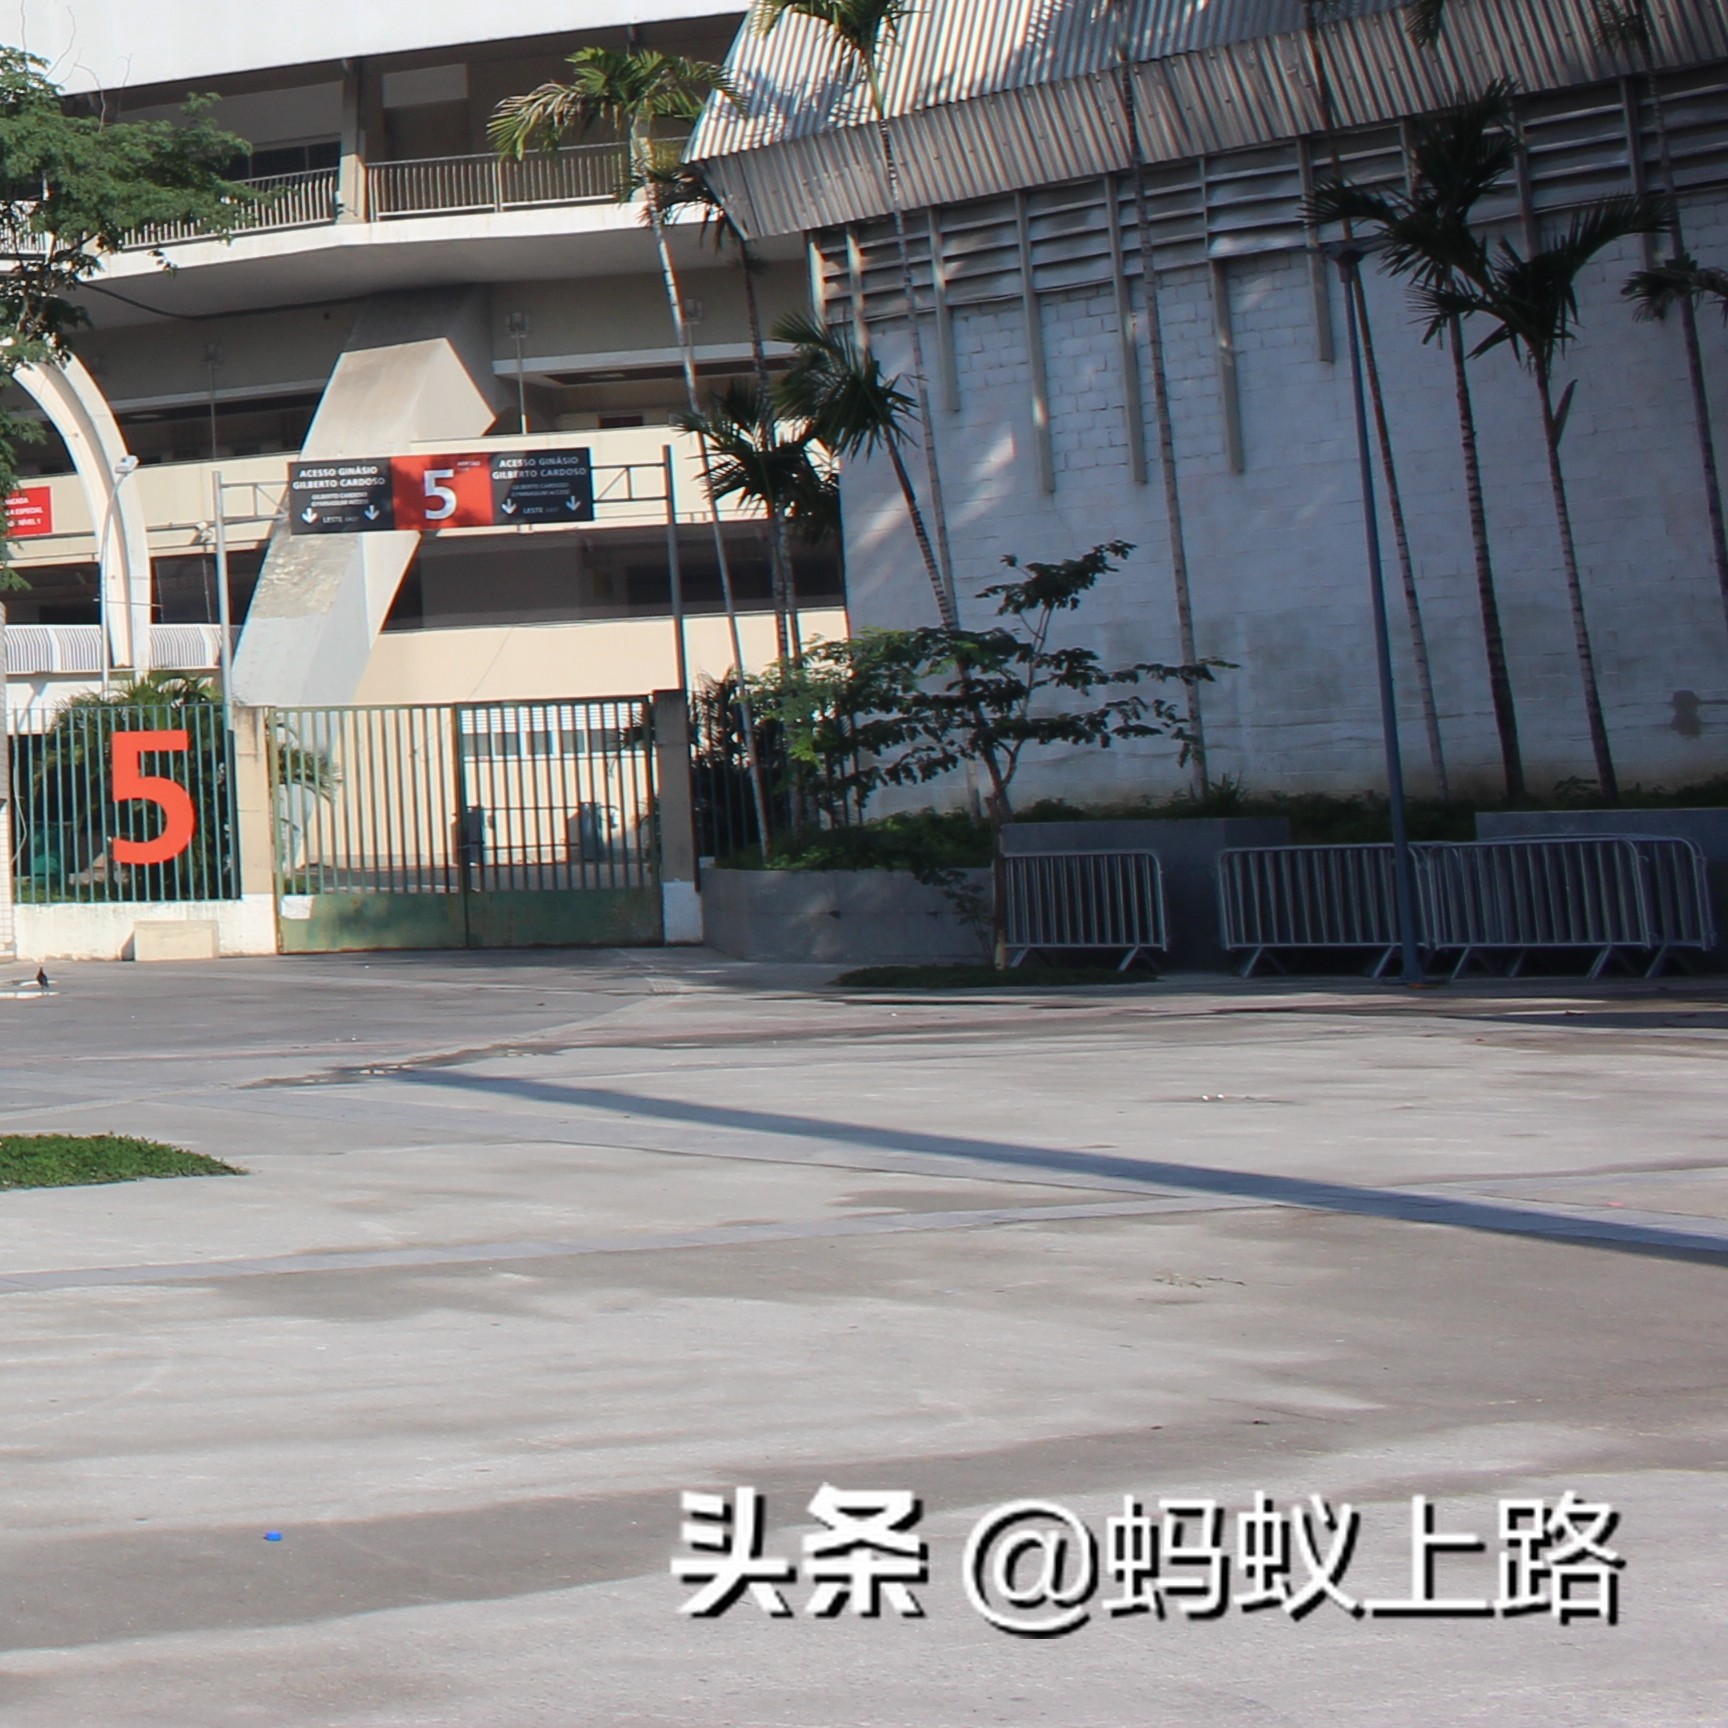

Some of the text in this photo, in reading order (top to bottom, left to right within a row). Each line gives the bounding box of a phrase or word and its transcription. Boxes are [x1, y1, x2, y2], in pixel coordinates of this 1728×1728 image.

[499, 456, 578, 468] ACESSO GINÁSIO
[299, 465, 378, 478] ACESSO GINÁSIO
[491, 467, 586, 480] GILBERTO CARDOSO
[292, 477, 386, 490] GILBERTO CARDOSO
[424, 468, 457, 520] 5
[111, 729, 197, 865] 5
